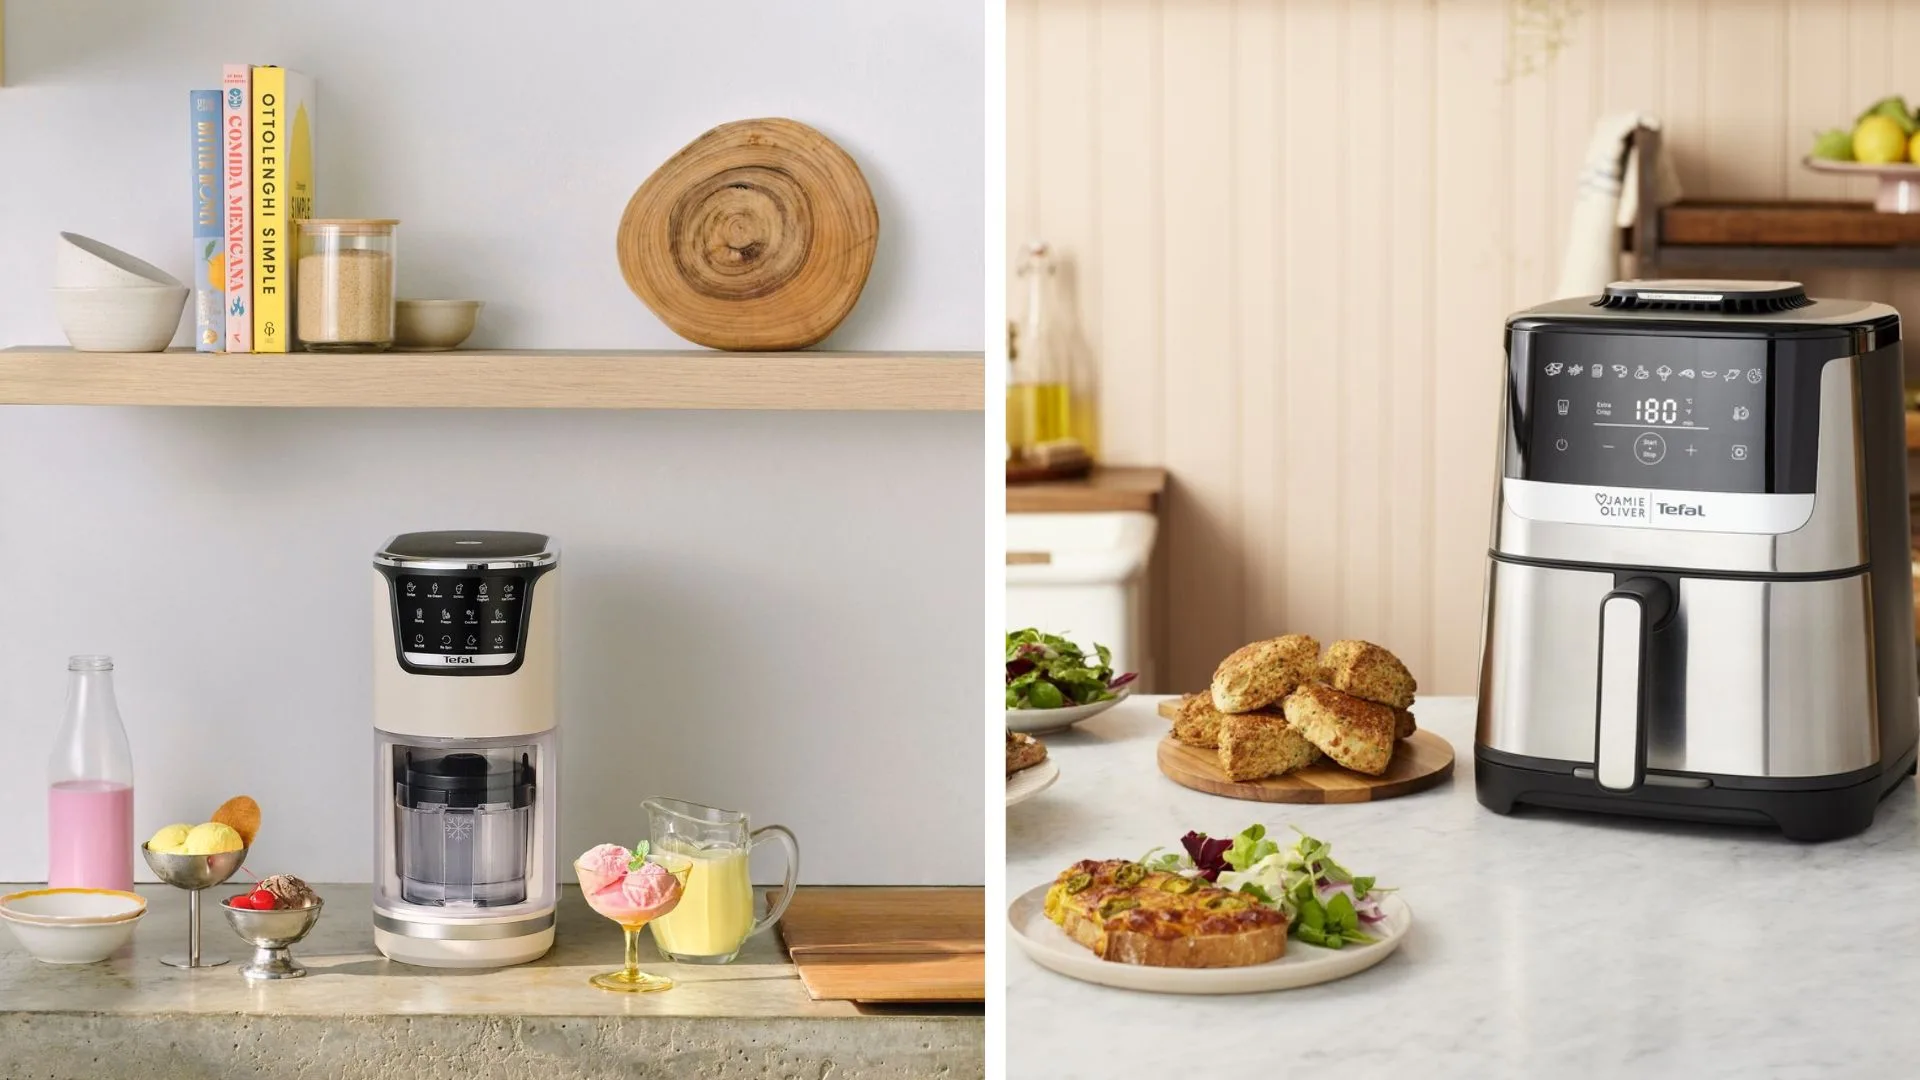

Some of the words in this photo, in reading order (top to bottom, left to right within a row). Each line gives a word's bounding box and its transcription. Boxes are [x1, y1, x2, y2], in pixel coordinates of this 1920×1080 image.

[228, 115, 243, 190] COMIDA
[262, 93, 275, 217] OTTOLENGHI
[291, 196, 310, 219] SIMPLE
[229, 195, 244, 292] MEXICANA
[262, 228, 275, 294] SIMPLE
[1636, 398, 1677, 424] 180
[1643, 451, 1657, 459] Stop
[1600, 506, 1645, 518] OLIVER
[1606, 495, 1645, 507] JAMIE
[1656, 502, 1706, 517] Tefal
[443, 656, 475, 664] Tefal
